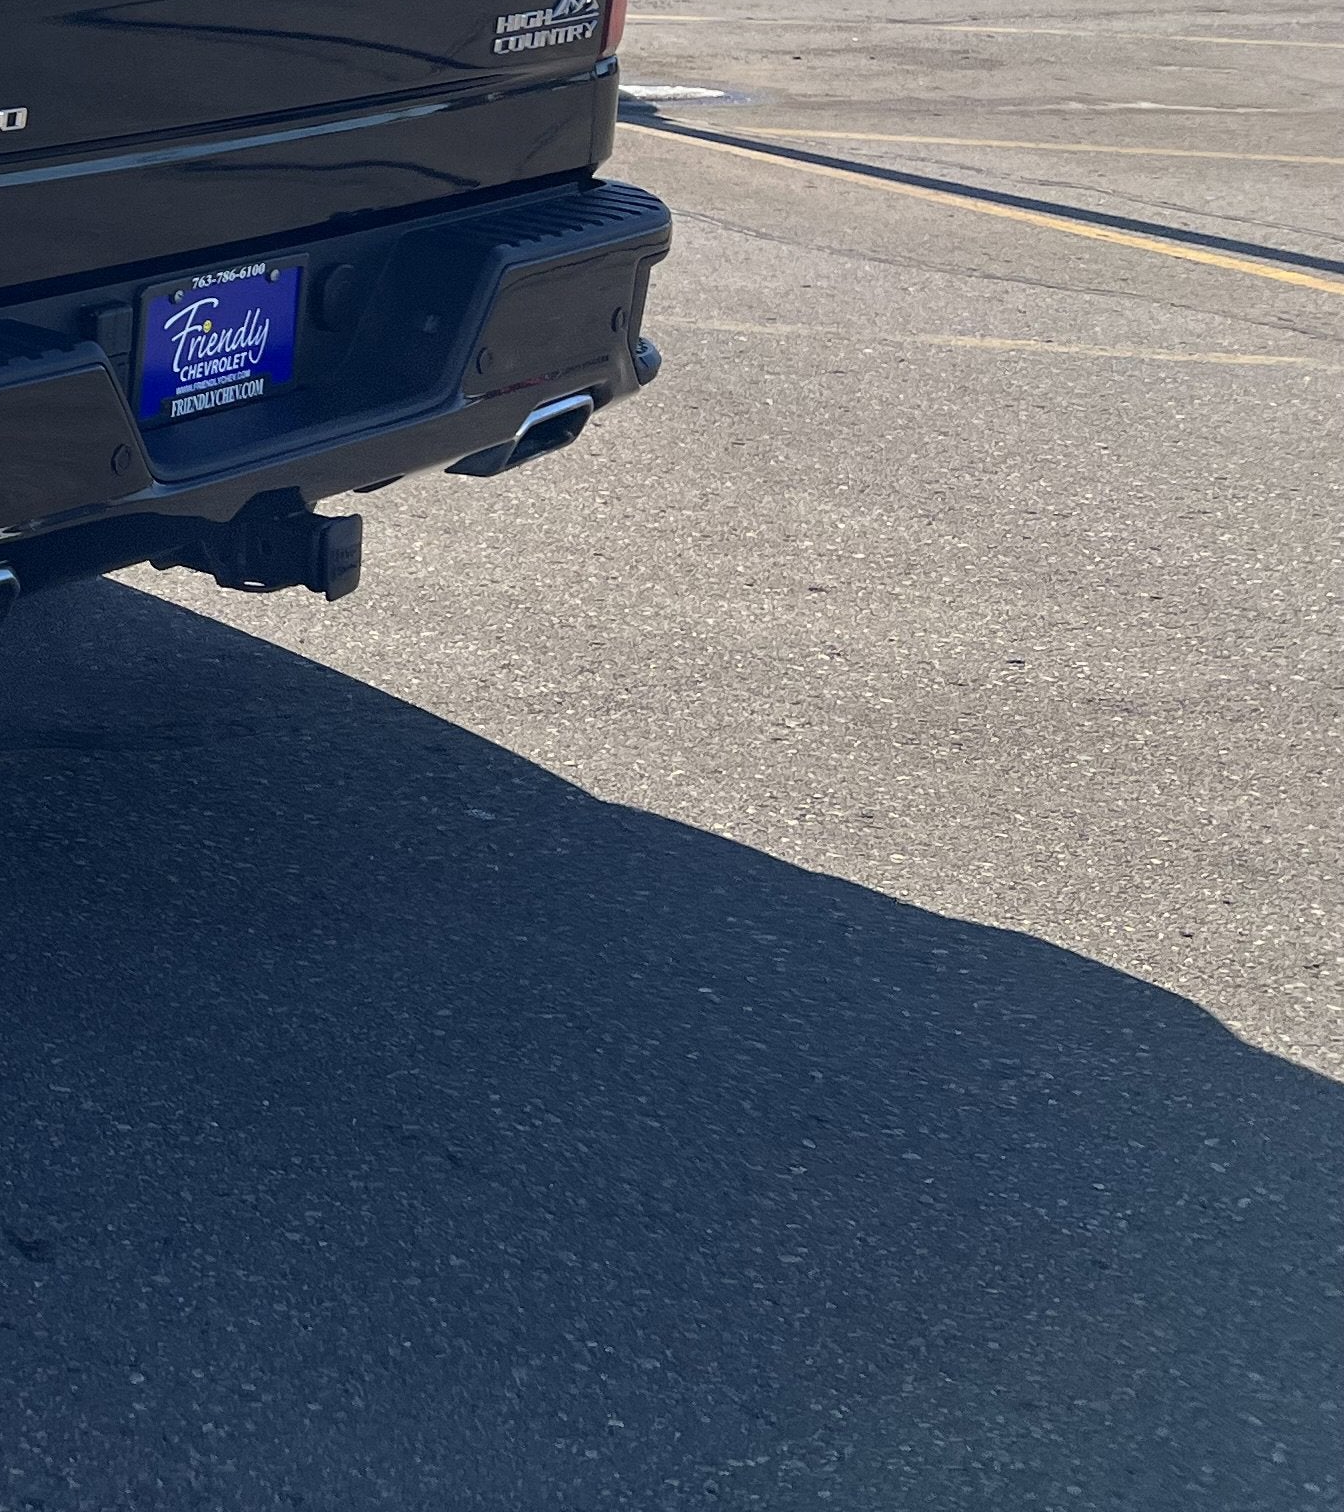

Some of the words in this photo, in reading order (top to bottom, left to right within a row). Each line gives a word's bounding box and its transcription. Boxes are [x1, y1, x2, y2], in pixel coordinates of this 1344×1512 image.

[493, 20, 598, 55] COUNTRY
[496, 8, 553, 34] HIGH
[191, 262, 266, 289] 763-786-6100
[164, 297, 270, 373] Friendly
[179, 351, 248, 382] CHEVROLET
[170, 378, 265, 418] FRIENDLYCHEV.COM
